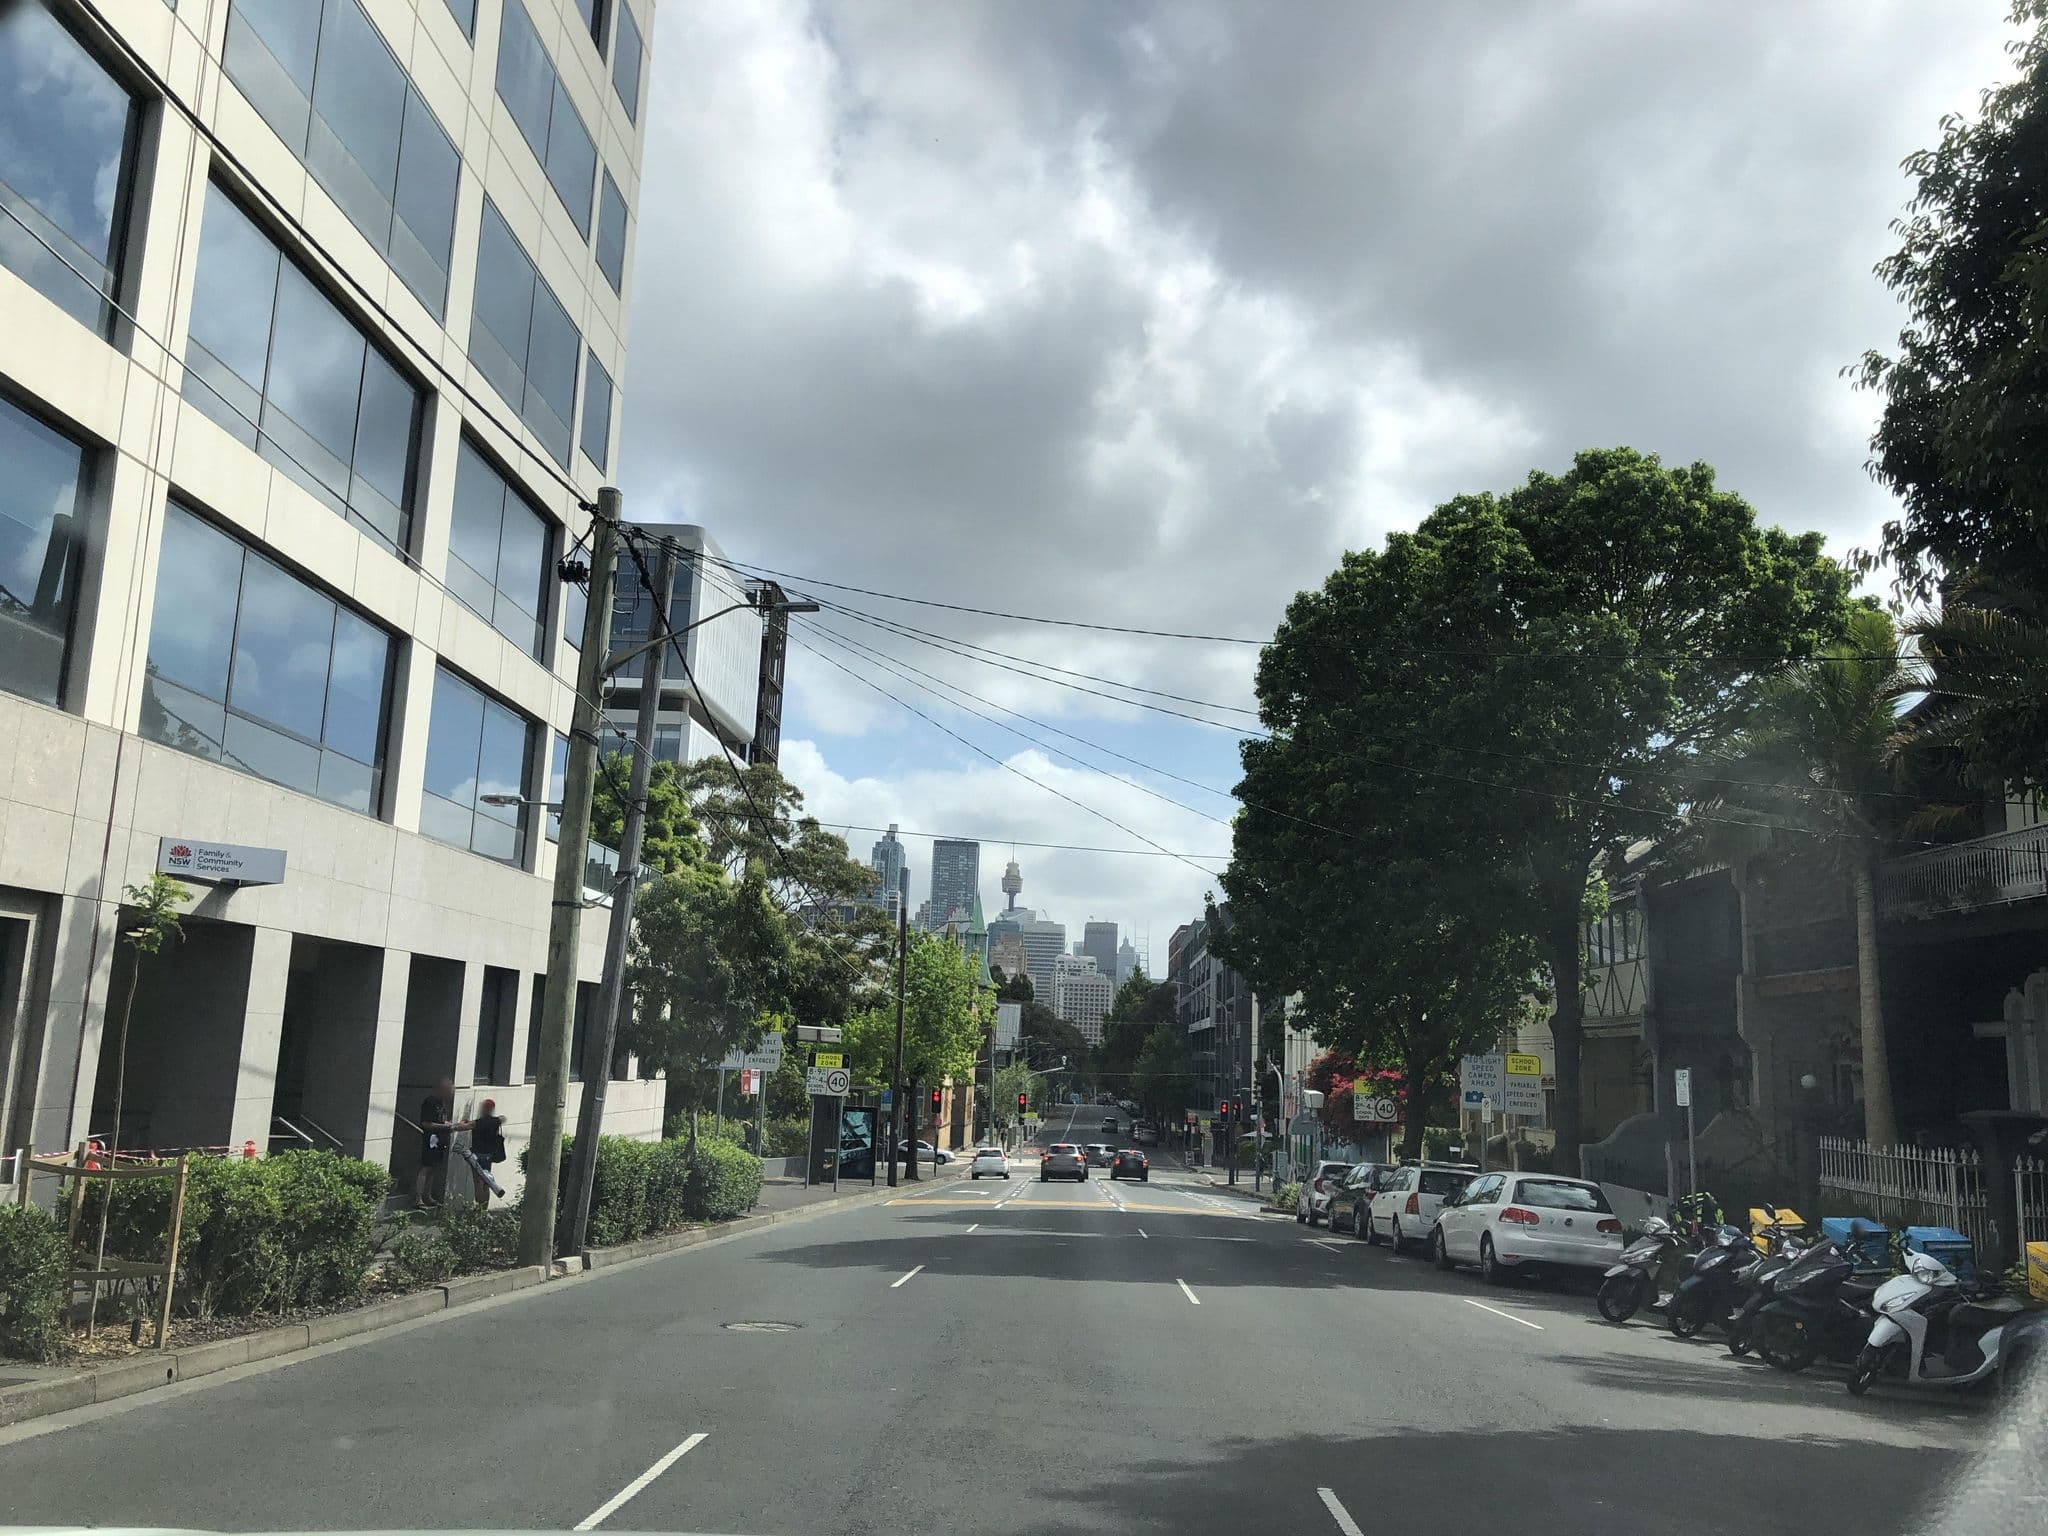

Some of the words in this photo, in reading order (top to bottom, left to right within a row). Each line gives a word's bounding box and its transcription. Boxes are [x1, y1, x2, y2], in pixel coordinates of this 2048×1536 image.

[198, 849, 224, 858] Family
[168, 857, 191, 865] NSW
[197, 856, 243, 868] Community
[196, 863, 229, 872] Services
[1468, 1072, 1497, 1080] CAMERA
[831, 1077, 845, 1087] 40
[1379, 1104, 1393, 1113] 40
